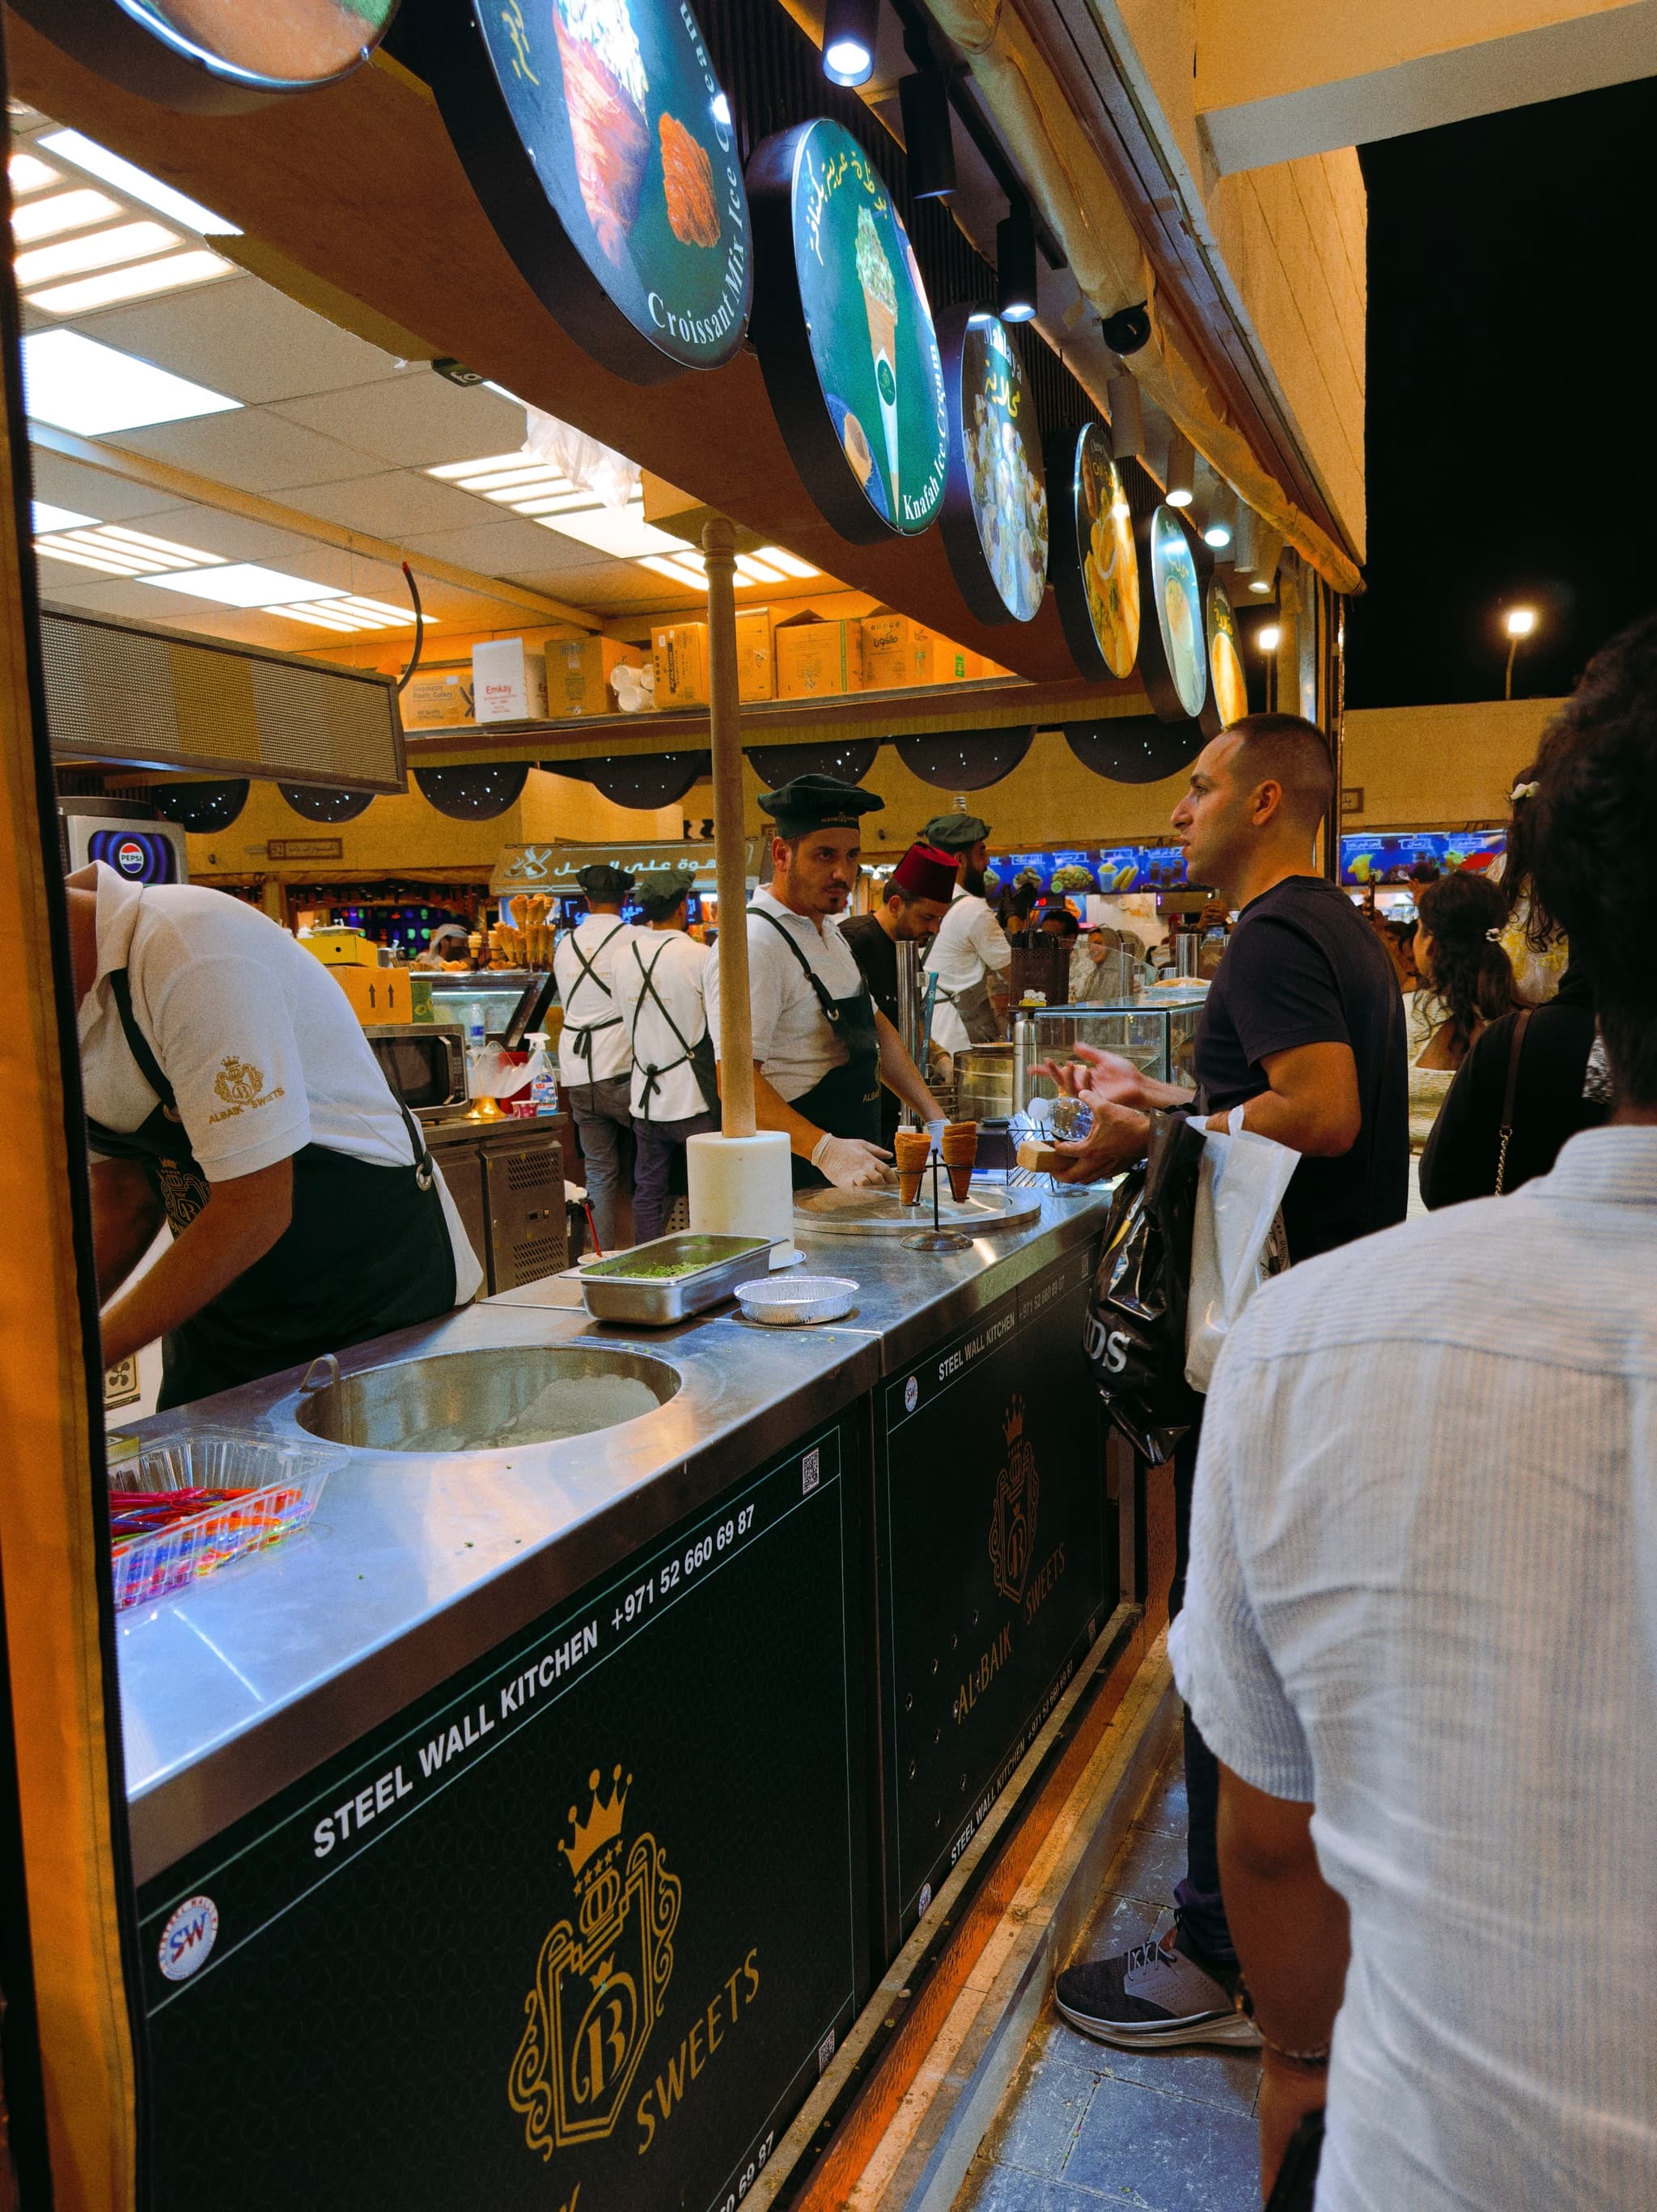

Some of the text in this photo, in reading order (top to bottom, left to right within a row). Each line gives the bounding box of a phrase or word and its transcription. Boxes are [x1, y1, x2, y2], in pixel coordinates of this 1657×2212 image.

[648, 2, 744, 344] Croissant Mix Ice Ceam
[903, 475, 940, 520] Knafah
[933, 441, 947, 481] Ice
[485, 684, 512, 697] Emkay
[121, 854, 142, 862] PEPSI
[676, 858, 718, 871] هوة
[208, 1087, 285, 1125] ALBAIK SWEETS
[939, 1352, 964, 1381] STEEL
[964, 1338, 985, 1361] WALL
[985, 1312, 1015, 1346] KITCHEN
[1025, 1541, 1066, 1626] SWEETS
[314, 1503, 755, 1858] STEEL WALL KITCHEN +971 52 660 69 87
[951, 1820, 976, 1865] STEEL
[976, 1787, 997, 1824] WALL
[996, 1738, 1026, 1788] KITCHEN
[169, 1911, 208, 1964] SW
[637, 1947, 760, 2156] SWEETS
[738, 2162, 756, 2199] 69
[758, 2130, 774, 2170] 87
